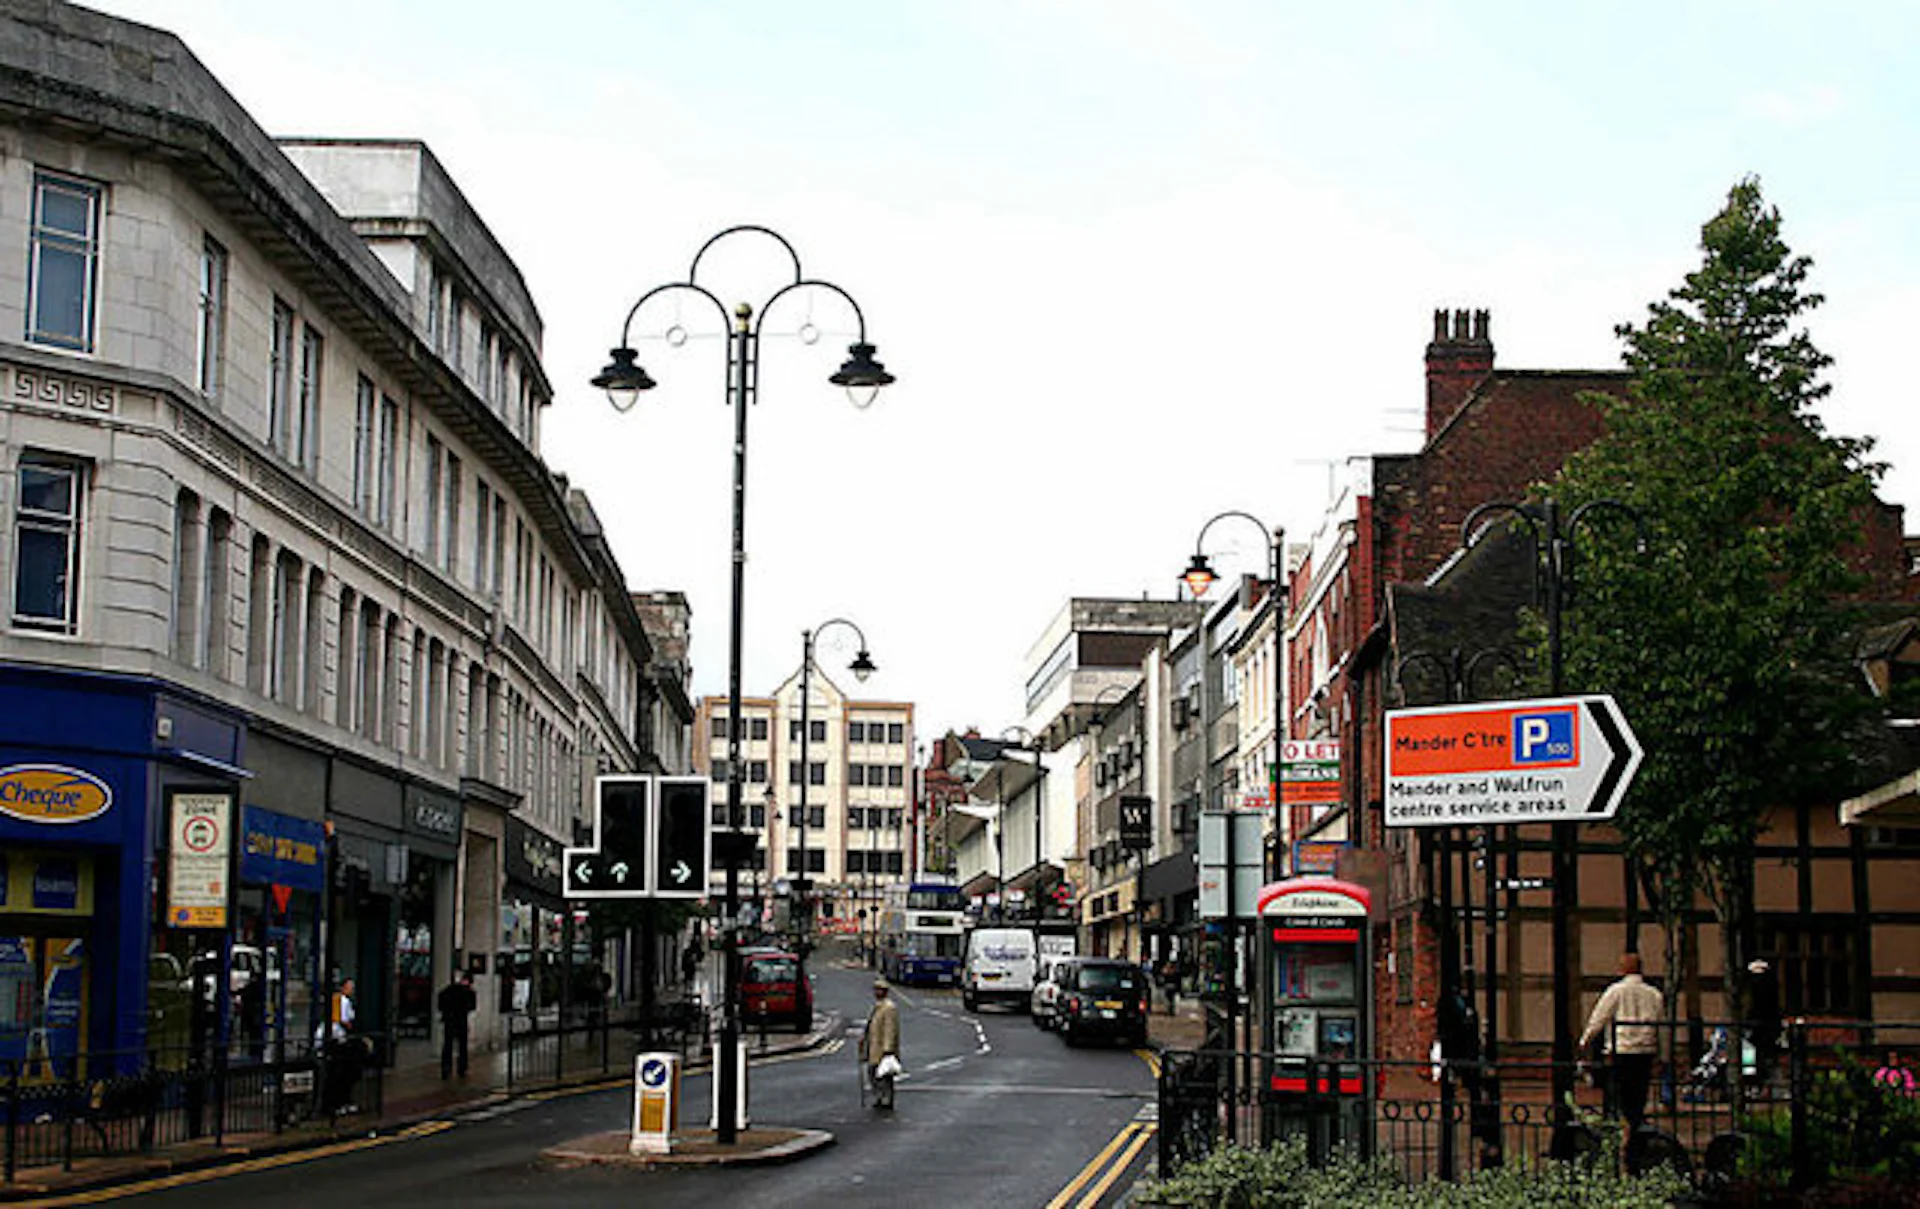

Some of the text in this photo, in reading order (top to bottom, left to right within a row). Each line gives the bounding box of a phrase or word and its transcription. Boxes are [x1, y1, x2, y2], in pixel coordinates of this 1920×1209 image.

[1396, 735, 1456, 750] Mander
[1522, 718, 1549, 758] P
[1305, 743, 1342, 760] LET
[2, 781, 82, 812] Cheque
[1390, 777, 1563, 797] Mander and Wulfrun
[1390, 798, 1566, 817] centre service areas
